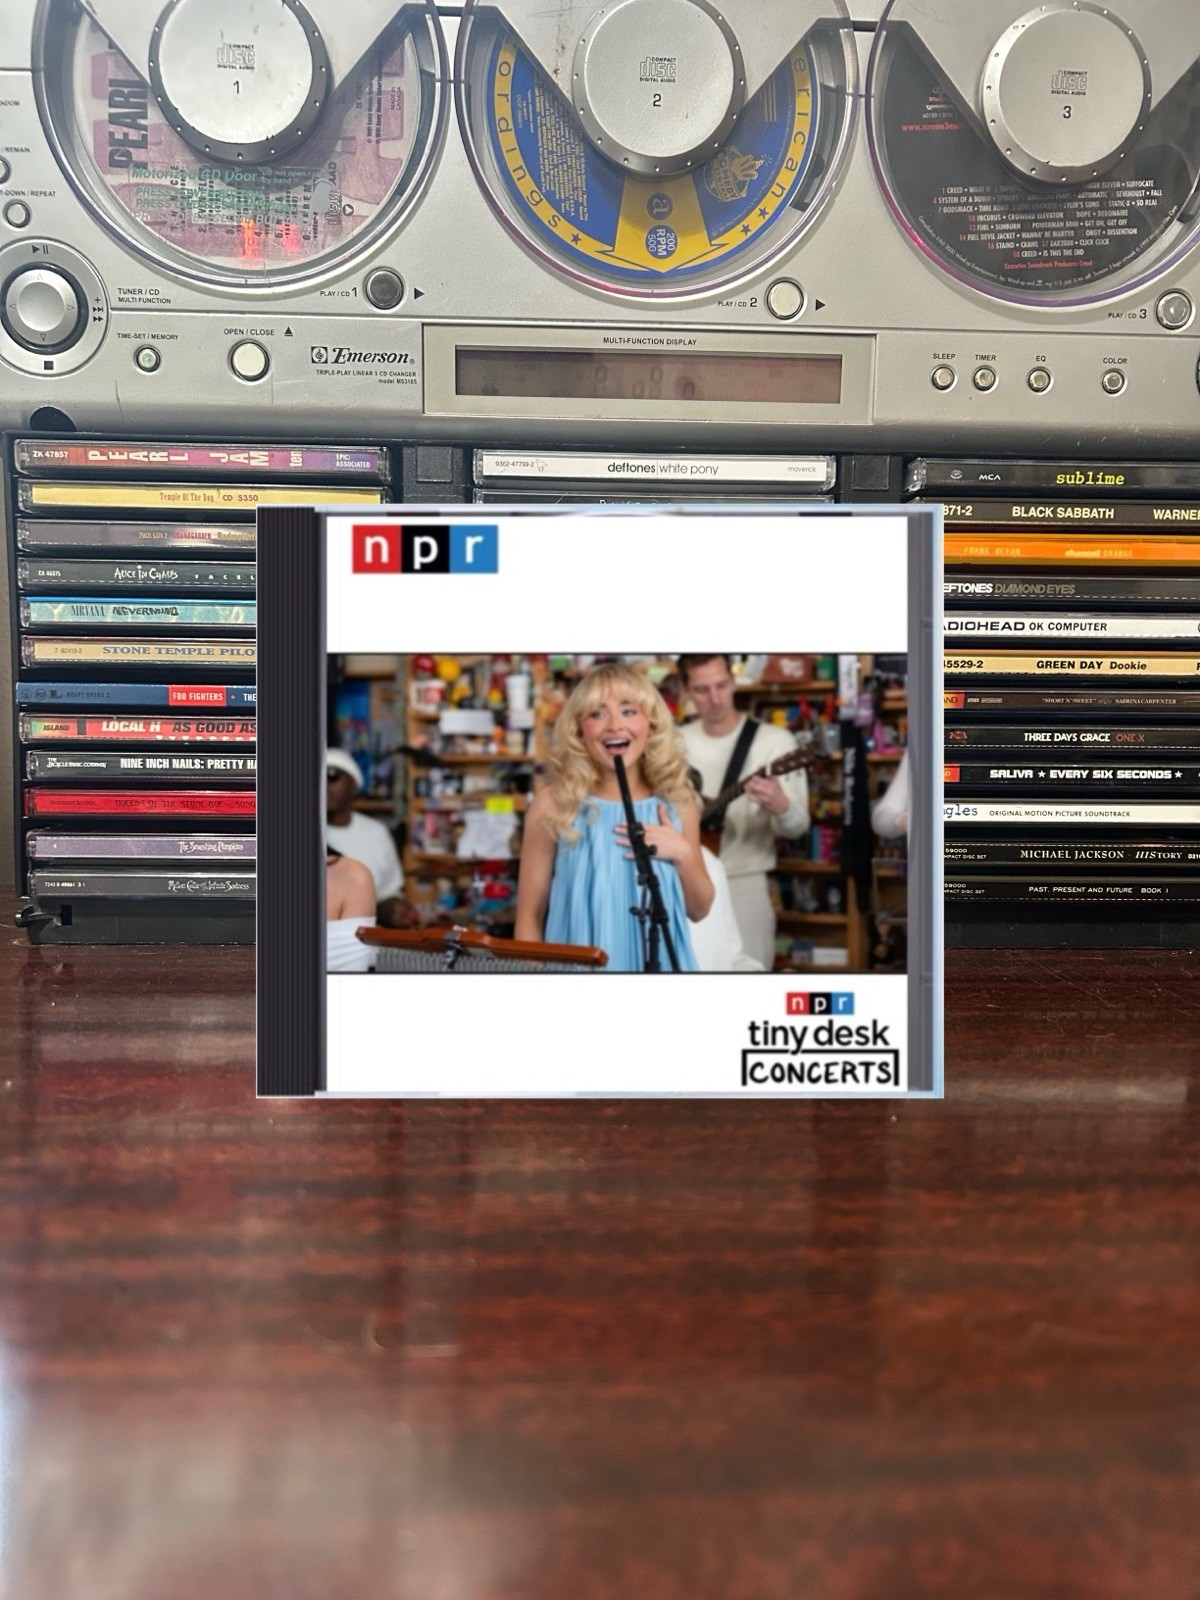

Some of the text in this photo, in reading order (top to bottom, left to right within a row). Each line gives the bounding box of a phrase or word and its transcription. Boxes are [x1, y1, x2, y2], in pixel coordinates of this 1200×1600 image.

[233, 80, 240, 94] 1
[653, 93, 661, 107] 2
[1063, 105, 1071, 119] 3
[224, 168, 258, 181] Door
[648, 234, 657, 251] 500
[656, 228, 667, 256] RPM
[666, 232, 676, 251] 200
[149, 288, 160, 296] CD
[351, 286, 357, 297] 1
[750, 297, 758, 308] 2
[1139, 308, 1147, 319] 3
[603, 336, 697, 346] MULTI-FUNCTION DISPLAY
[330, 347, 409, 364] Emerson
[1035, 355, 1047, 363] EQ
[33, 450, 69, 458] ZK 47857
[88, 450, 189, 461] PEARL
[209, 450, 270, 467] JAM
[336, 460, 371, 468] ASSOCIATED
[607, 462, 719, 475] deftones white pony
[1056, 471, 1125, 485] sublime
[159, 493, 183, 501] Temple
[203, 493, 214, 502] Dog
[238, 494, 258, 502] 5350
[1012, 506, 1054, 518] BLACK
[1056, 507, 1115, 519] SABBATH
[363, 534, 484, 570] npr
[963, 546, 1133, 558] FRANK OCEAN channel ORANGE
[114, 567, 136, 580] ALICE
[995, 583, 1046, 593] DIAMOND
[1046, 584, 1076, 594] EYES
[71, 605, 179, 617] NIRVANA NEVERMIND
[944, 621, 1108, 631] DIOHEAD OK COMPUTER
[102, 646, 151, 655] STONE
[155, 647, 215, 656] TEMPLE
[1036, 660, 1075, 669] GREEN
[1079, 661, 1103, 670] DAY
[1109, 661, 1147, 670] Dookie
[173, 692, 256, 702] FOO FIGHTERS THE
[102, 720, 146, 732] LOCAL
[149, 721, 161, 732] H
[172, 721, 192, 733] AS
[195, 721, 235, 734] GOOD
[1024, 732, 1052, 742] THREE
[1054, 733, 1078, 742] DAYS
[1079, 733, 1110, 742] GRACE
[120, 758, 143, 769] NINE
[146, 758, 170, 769] INCH
[172, 759, 204, 769] NAILS:
[207, 759, 244, 770] PRETTY
[989, 769, 1172, 779] SALIVA EVERY SIX SECONDS
[1084, 810, 1131, 818] SOUNDTRACK
[178, 841, 244, 854] The Smashing Pumpkins
[1020, 850, 1072, 859] MICHAEL
[1074, 850, 1125, 860] JACKSON
[790, 996, 848, 1014] npr
[748, 1019, 890, 1055] tiny desk
[748, 1060, 892, 1084] CONCERTS
